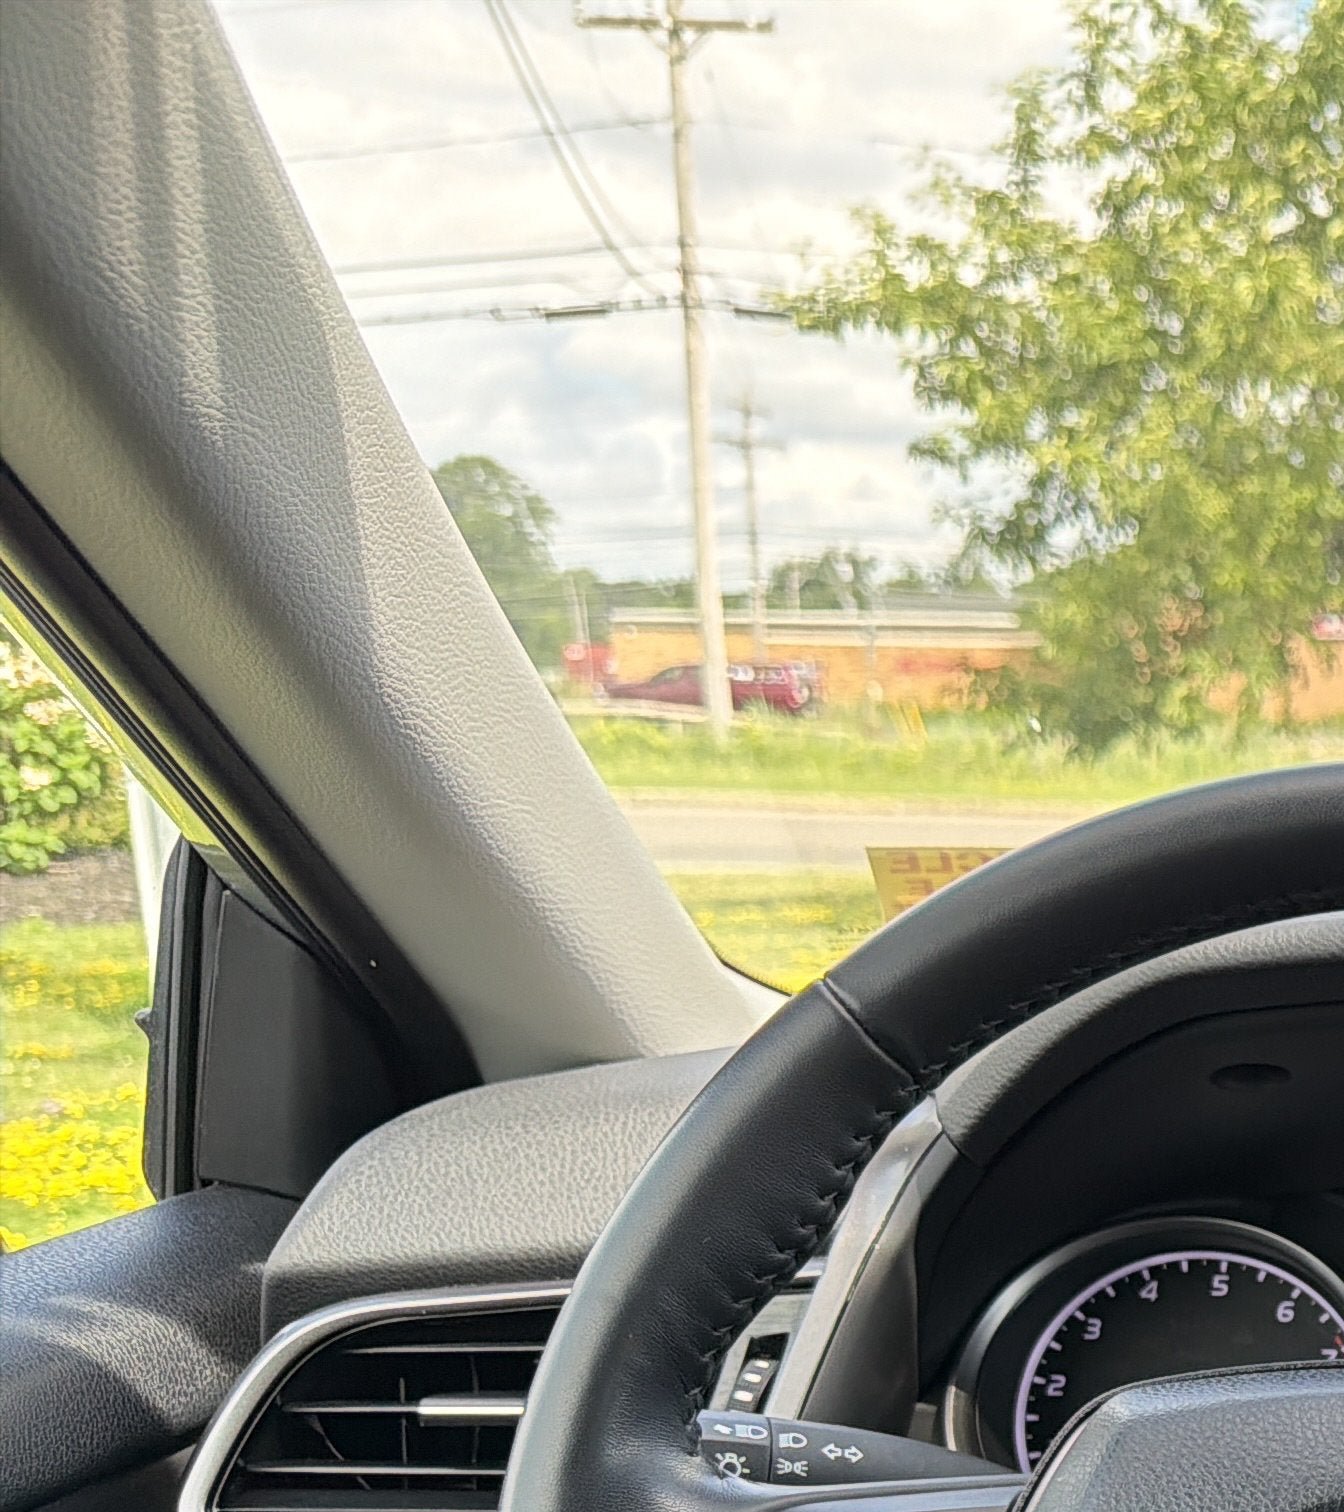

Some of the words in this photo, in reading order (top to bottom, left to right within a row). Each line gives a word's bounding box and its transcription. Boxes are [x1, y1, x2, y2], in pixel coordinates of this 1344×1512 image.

[1138, 1280, 1159, 1302] 4
[1211, 1274, 1230, 1298] 5
[1276, 1300, 1295, 1323] 6
[1083, 1318, 1102, 1341] 3
[1045, 1375, 1067, 1397] 2
